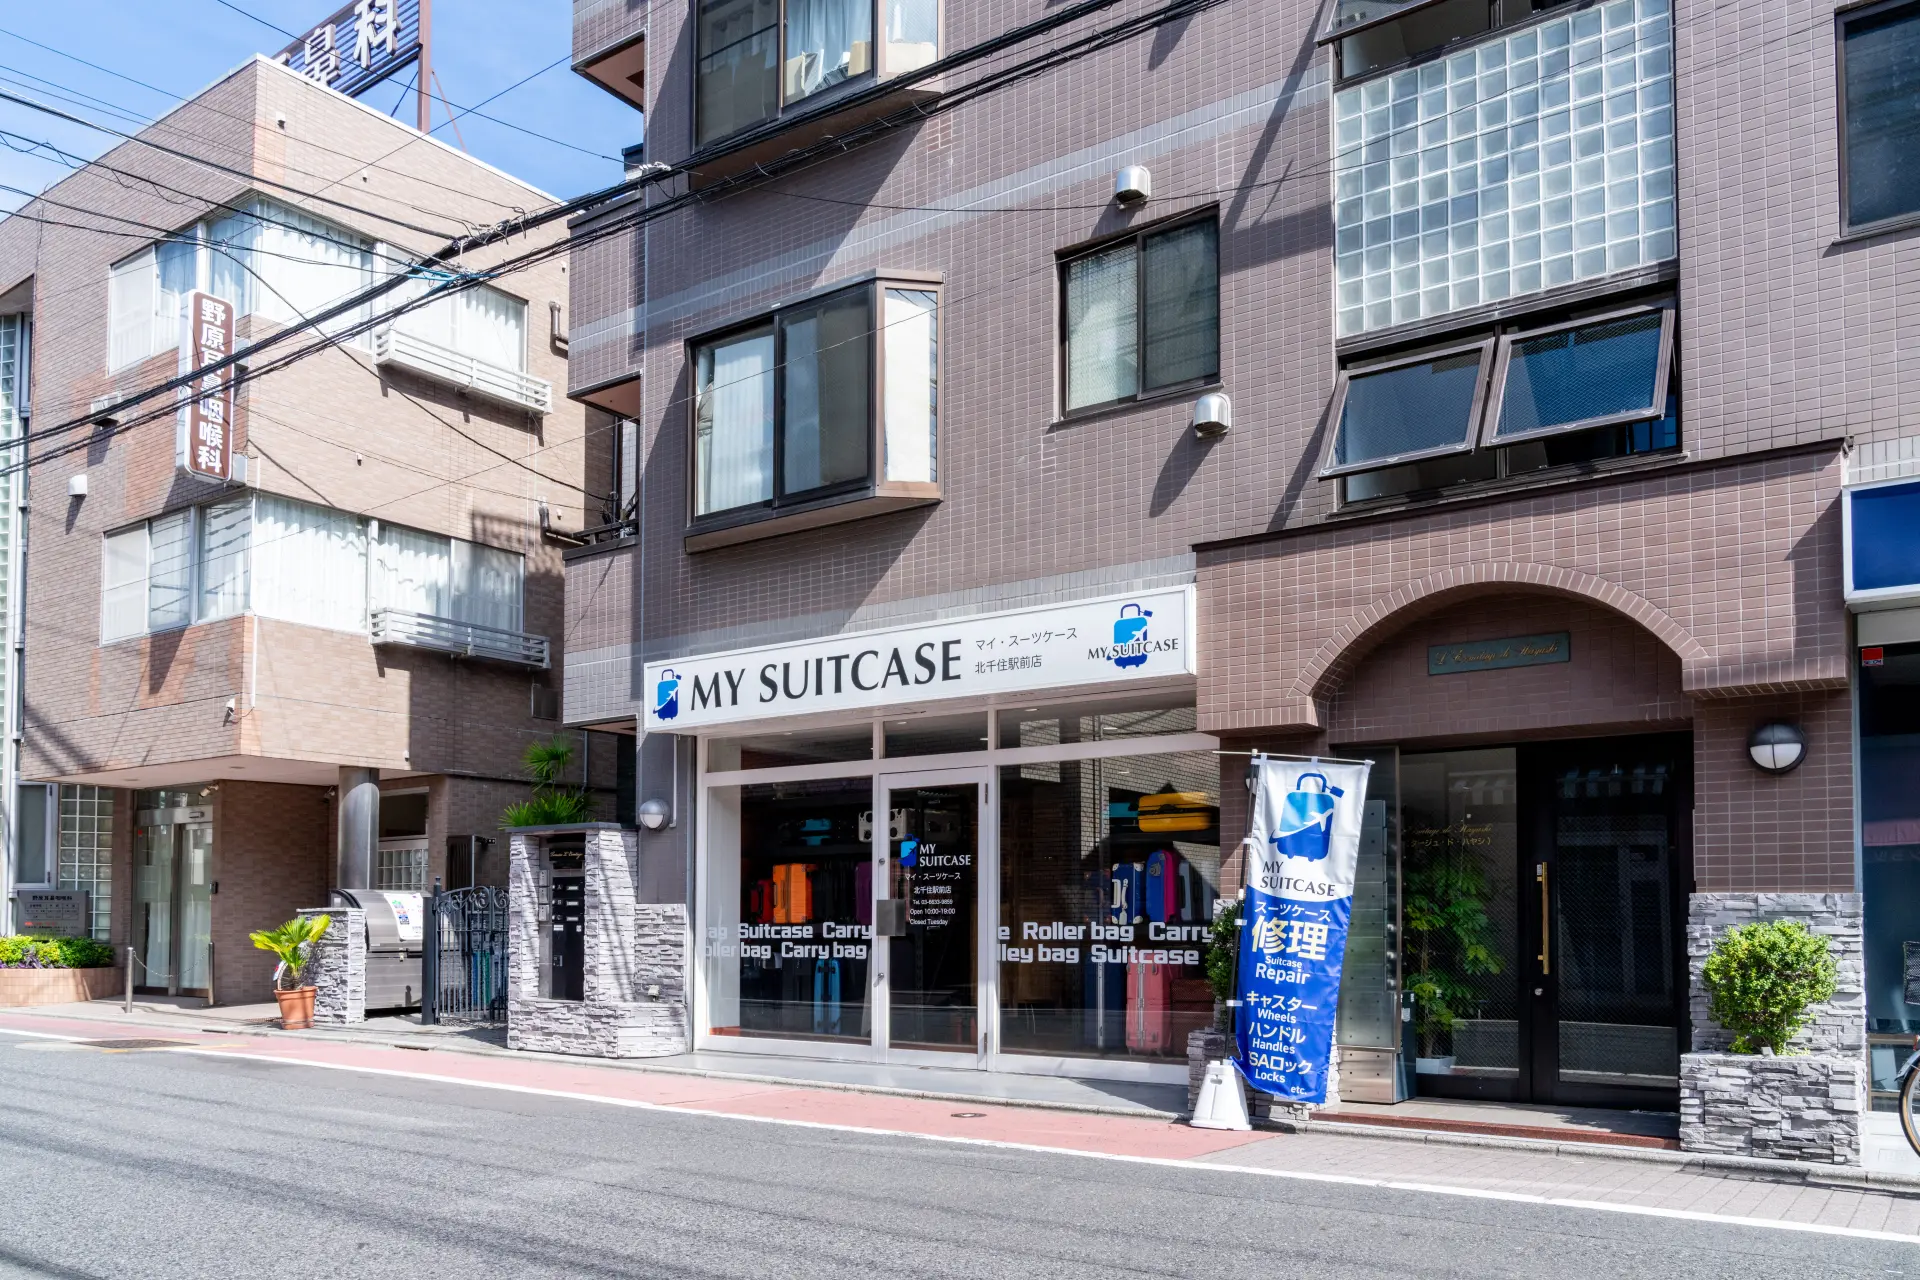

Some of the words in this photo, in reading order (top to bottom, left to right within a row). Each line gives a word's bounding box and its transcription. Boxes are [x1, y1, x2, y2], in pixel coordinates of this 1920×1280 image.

[975, 627, 1078, 651] マイ・スーツケース
[1087, 647, 1109, 661] MY
[1111, 637, 1179, 658] SUITCASE
[691, 668, 746, 711] MY
[759, 638, 962, 703] SUITCASE
[975, 654, 1043, 675] 北千住駅前店
[920, 844, 936, 854] MY
[920, 855, 971, 866] SUITCASE
[1262, 861, 1284, 874] MY
[914, 886, 951, 894] 北千住駅前店
[1260, 876, 1336, 897] SUITCASE
[1254, 901, 1331, 922] スーツケース
[738, 923, 814, 939] Suitcase
[822, 922, 872, 940] Carry
[1023, 922, 1087, 940] Roller
[1090, 922, 1134, 942] bag
[1148, 922, 1215, 943] Carry
[1251, 914, 1329, 961] 修理
[740, 942, 771, 958] bag
[781, 941, 829, 960] Carry
[832, 942, 867, 960] bag
[1037, 944, 1080, 964] bag
[1090, 944, 1200, 965] Suitcase
[1264, 955, 1303, 969] Suitcase
[1255, 962, 1311, 985] Repair
[1246, 990, 1318, 1012] キャスター
[1257, 1008, 1297, 1024] Wheels
[1248, 1021, 1307, 1044] ハンドル
[1252, 1037, 1296, 1055] Handles
[1248, 1050, 1313, 1075] SAロック
[1254, 1068, 1286, 1083] Locks
[1290, 1085, 1307, 1095] etc.
